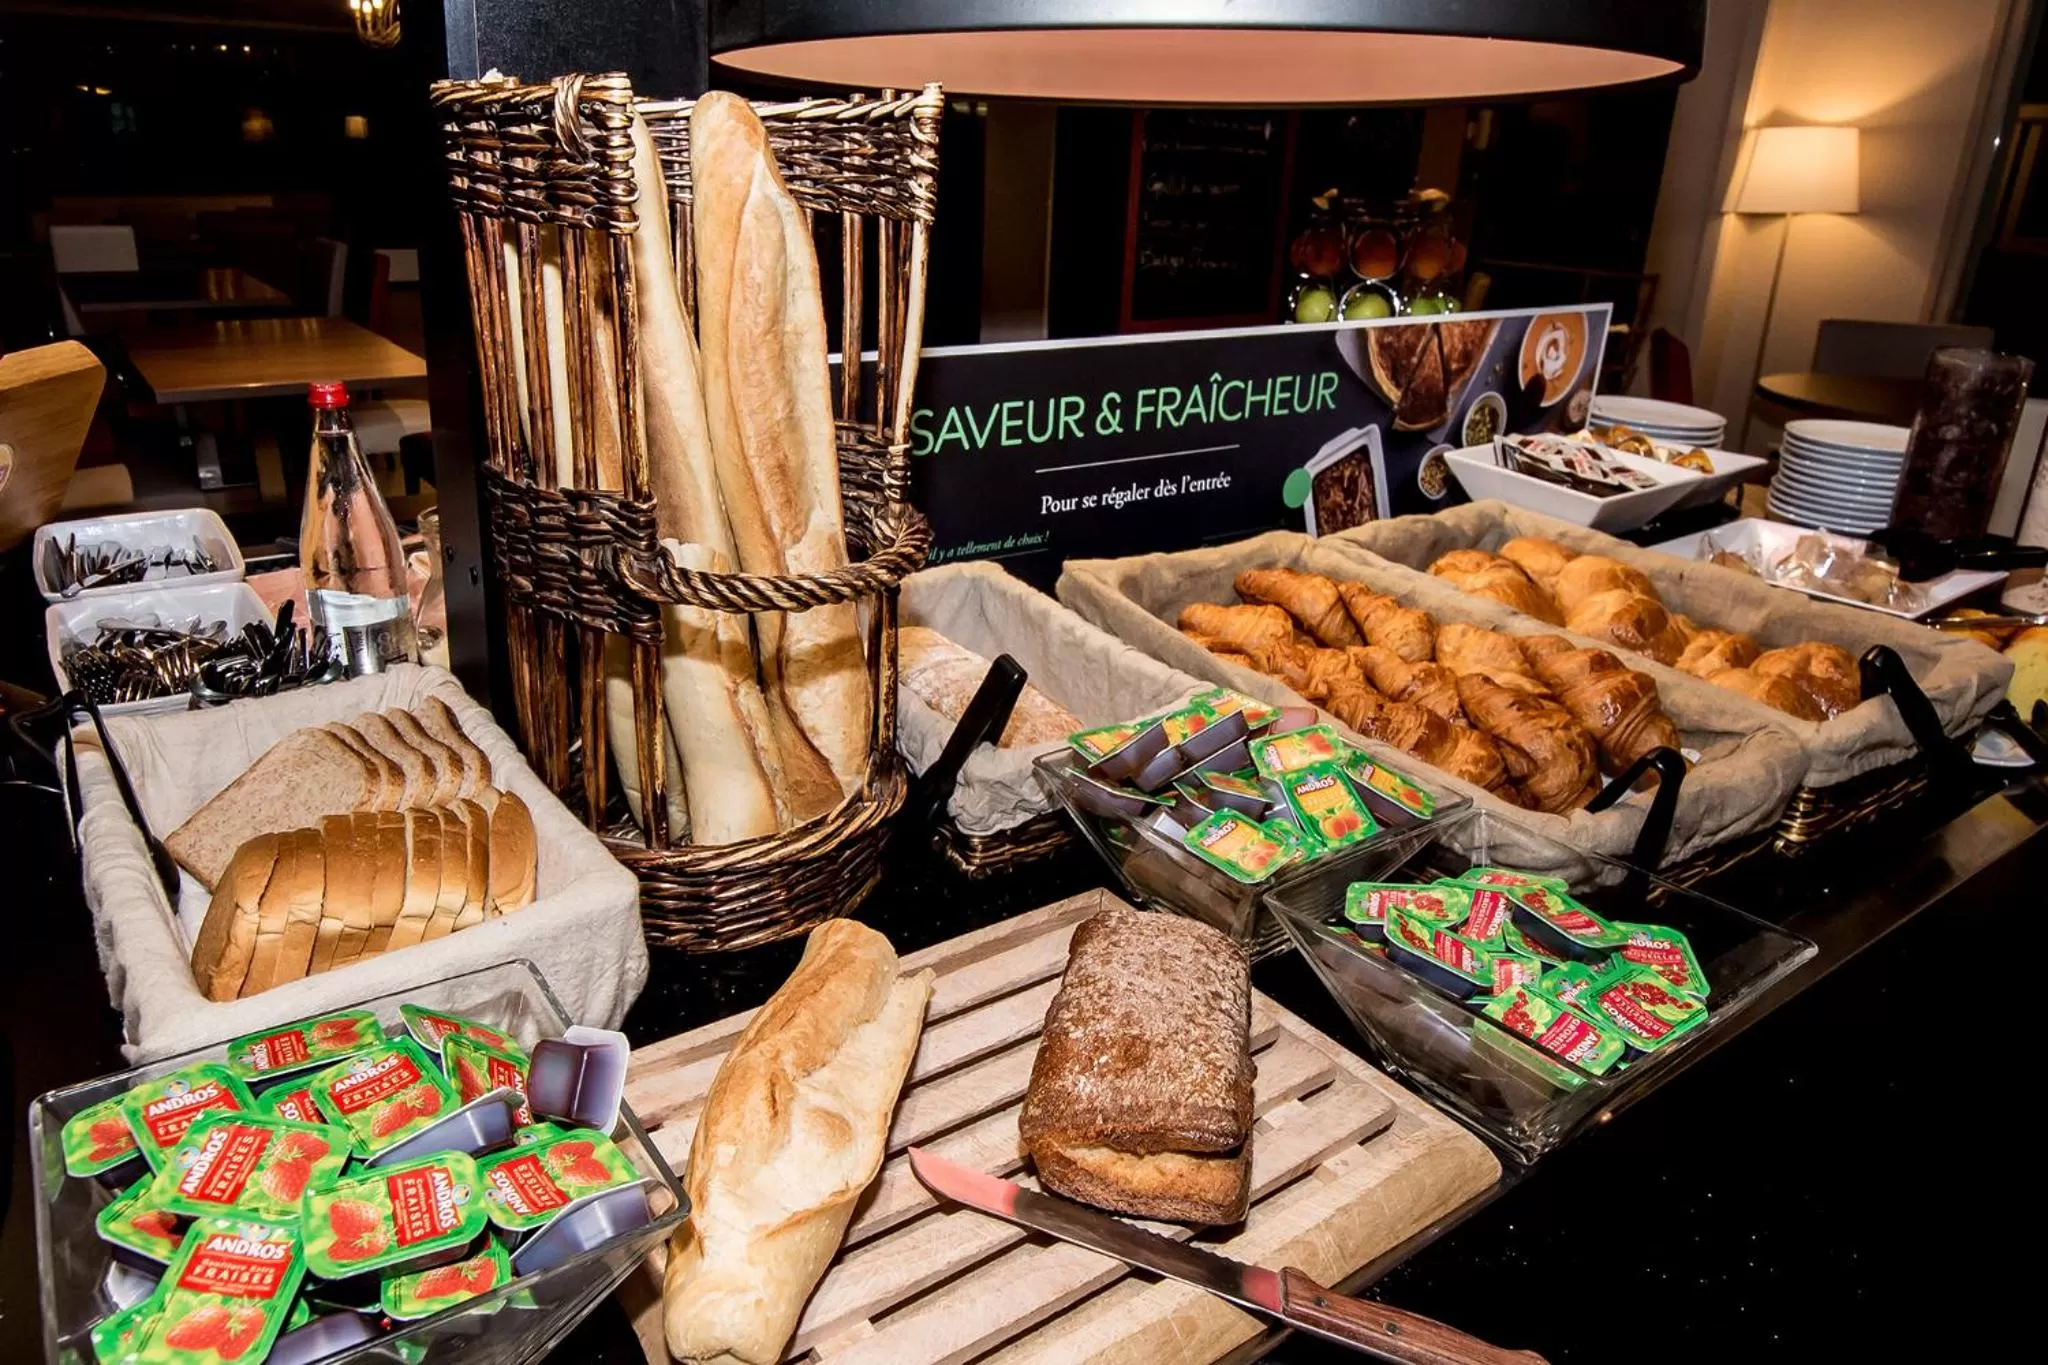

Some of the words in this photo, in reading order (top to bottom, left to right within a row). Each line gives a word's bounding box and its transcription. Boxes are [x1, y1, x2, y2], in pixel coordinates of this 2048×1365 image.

[910, 395, 1086, 456] SAVEUR
[1094, 391, 1124, 436] &
[1135, 371, 1339, 431] FRAÎCHEUR
[1040, 494, 1078, 514] Pour
[1082, 494, 1097, 508] se
[1101, 482, 1151, 509] régaler
[1154, 479, 1177, 498] dès
[956, 541, 1001, 557] tellement
[1003, 535, 1015, 549] de
[1016, 532, 1043, 546] choix
[1296, 775, 1336, 796] ANDROS
[1202, 819, 1238, 847] ANDROS
[1487, 897, 1508, 937] ANDROS
[1627, 938, 1671, 950] NDROS
[1602, 1001, 1653, 1038] ANDROS
[1565, 1031, 1599, 1062] ANDRO
[334, 1056, 400, 1093] ANDROS
[343, 1070, 410, 1105] FRAISES
[149, 1085, 220, 1117] ANDROS
[181, 1129, 229, 1194] ANDROS
[211, 1135, 254, 1198] FRAISES
[431, 1171, 457, 1229] ANDROS
[490, 1170, 530, 1215] ANDROS
[517, 1164, 555, 1206] FRAISES
[403, 1178, 424, 1237] FRAISES
[205, 1236, 288, 1260] ANDROS
[192, 1264, 275, 1285] FRAISES
